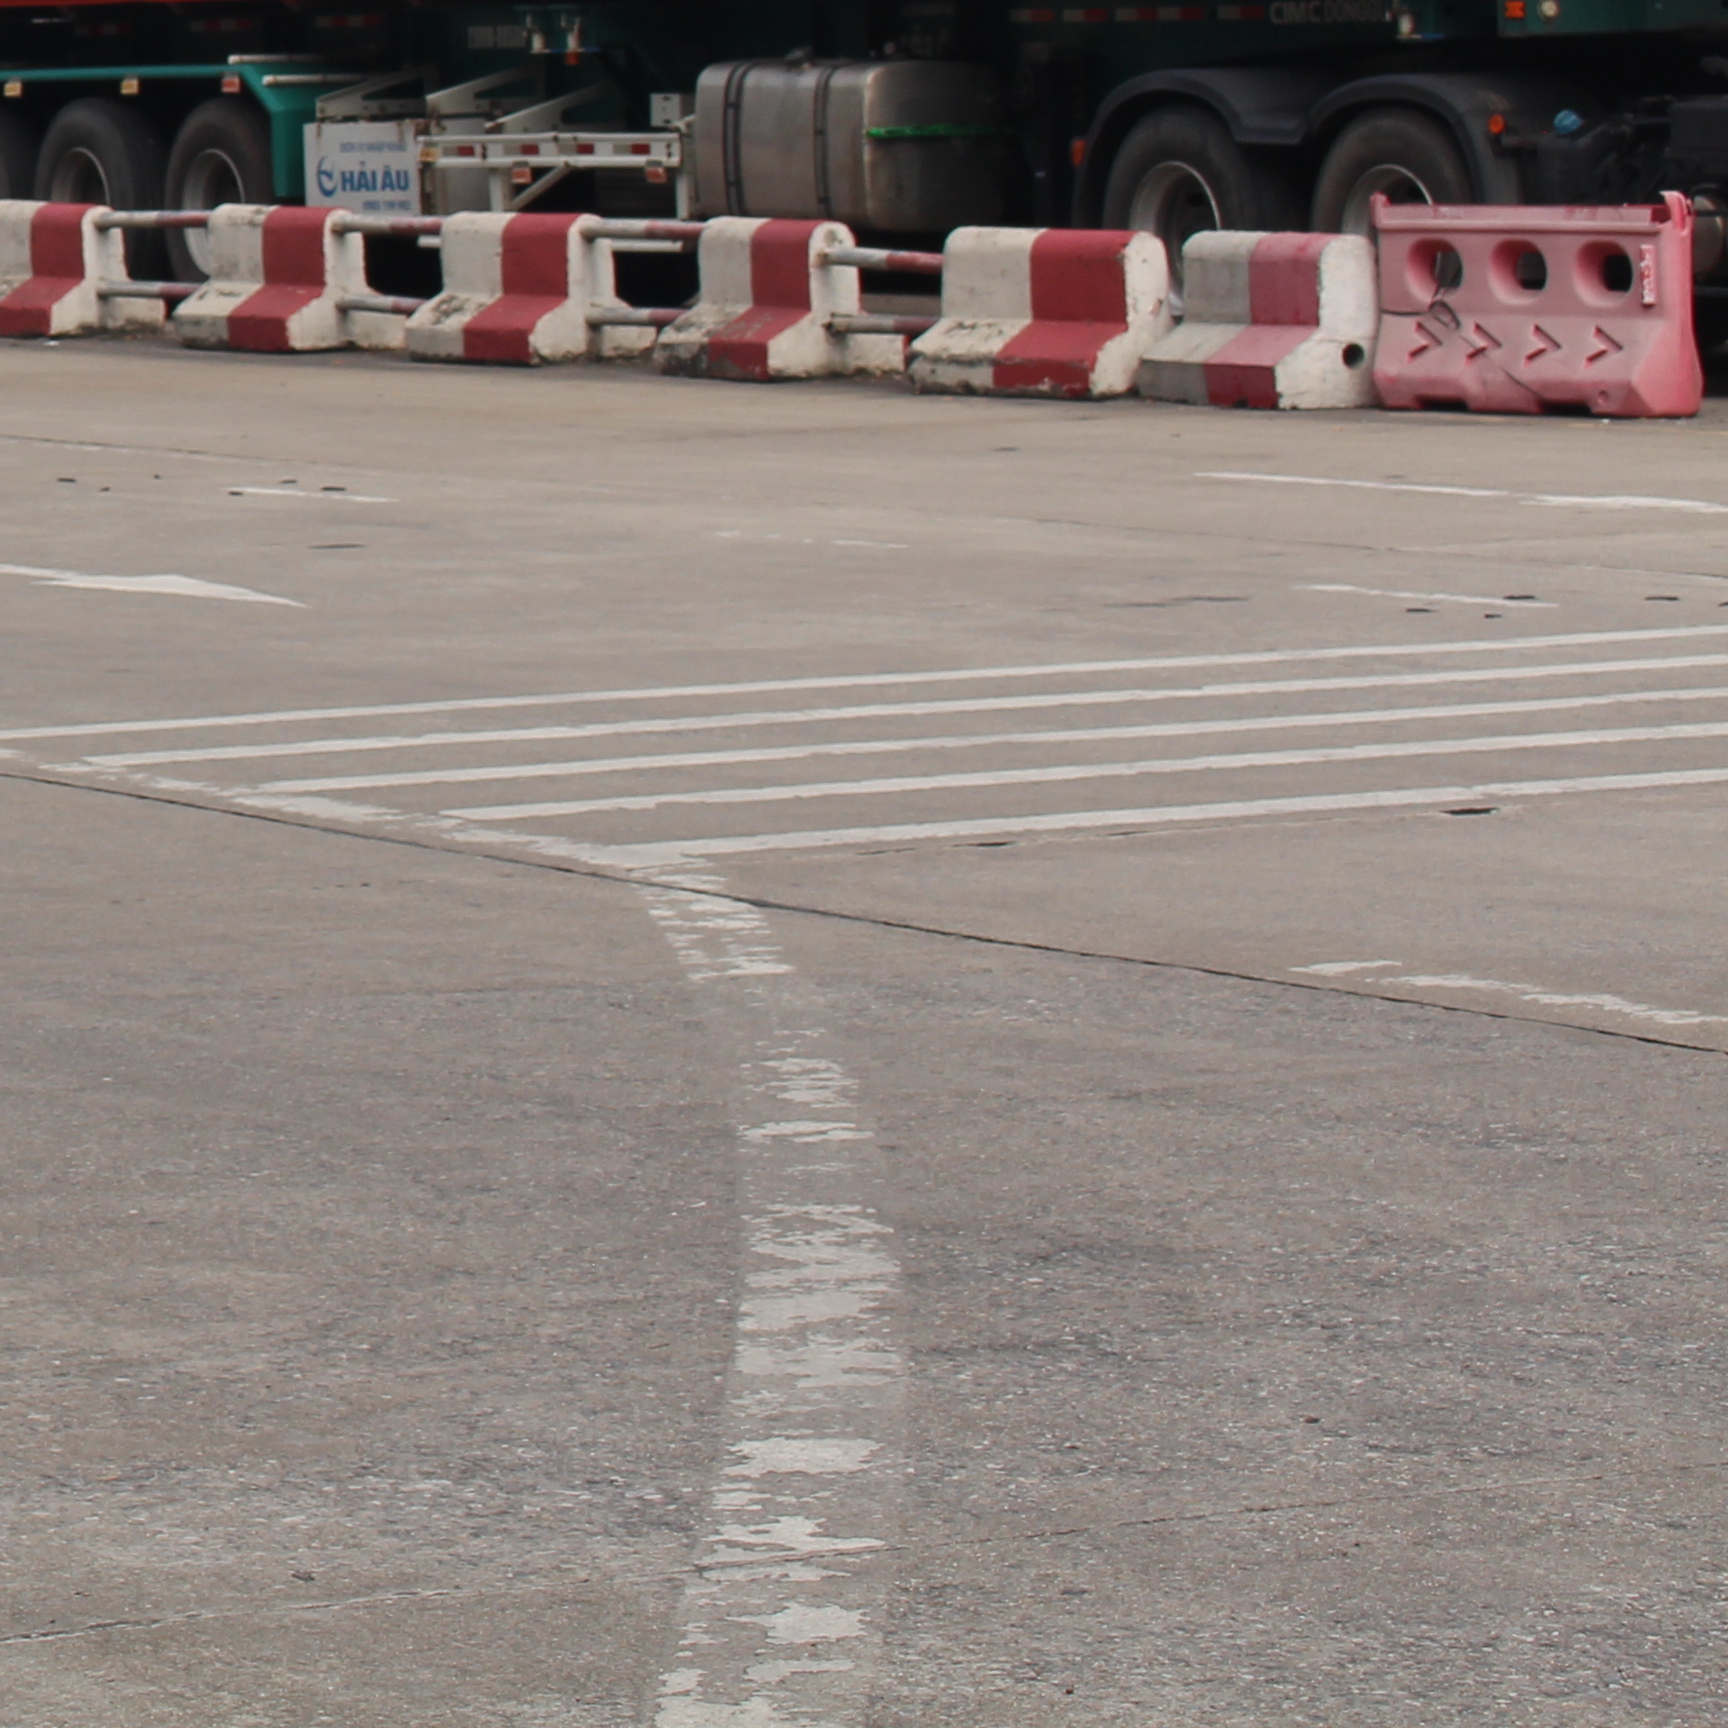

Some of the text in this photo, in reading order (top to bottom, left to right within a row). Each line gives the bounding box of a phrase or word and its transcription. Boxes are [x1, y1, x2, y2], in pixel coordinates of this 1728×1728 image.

[1269, 1, 1319, 24] CIMC
[340, 160, 410, 192] HẢI ÂU
